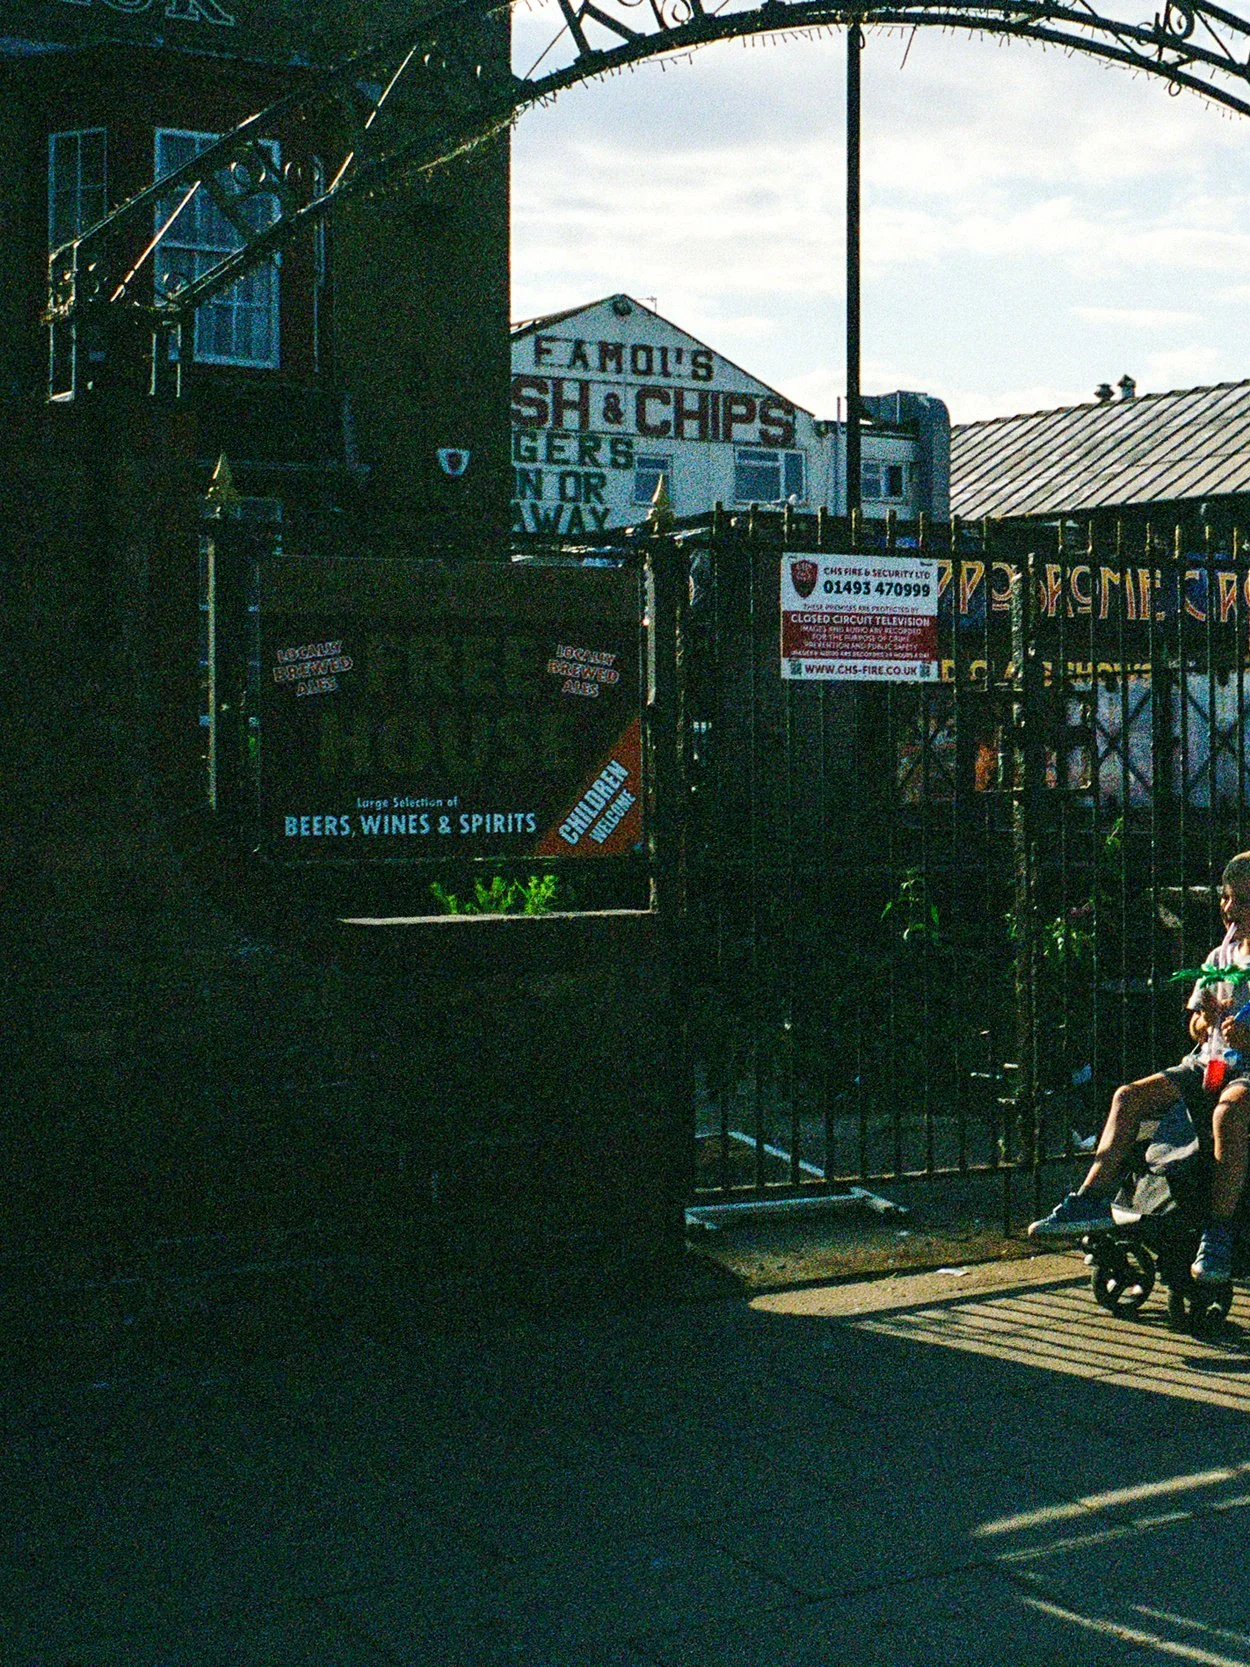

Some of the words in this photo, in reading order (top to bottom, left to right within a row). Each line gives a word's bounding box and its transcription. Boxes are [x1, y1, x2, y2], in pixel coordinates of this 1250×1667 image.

[602, 392, 624, 425] &
[635, 385, 797, 446] CHIPS
[559, 470, 607, 504] OR
[823, 567, 843, 576] CHS
[844, 567, 863, 577] FIRE
[872, 568, 914, 579] SECURITY
[915, 570, 931, 580] LTD
[823, 580, 871, 596] 01493
[874, 581, 931, 598] 470999
[790, 614, 831, 625] CLOSED
[832, 614, 873, 626] CIRCUIT
[875, 616, 931, 628] TELEVISION
[277, 640, 343, 663] LOCALLY
[272, 656, 353, 682] BREWED
[547, 658, 620, 684] BREWED
[804, 663, 918, 677] WWW.CHS-FIRE.CO.UK
[561, 679, 600, 698] ALES
[356, 796, 390, 811] Large
[393, 796, 443, 808] Selection
[446, 795, 459, 808] of
[559, 760, 629, 845] CHILDREN
[284, 814, 356, 839] BEERS,
[360, 813, 431, 835] WINES
[438, 815, 453, 835] &
[459, 813, 537, 835] SPIRITS
[589, 788, 637, 844] WELCOME
